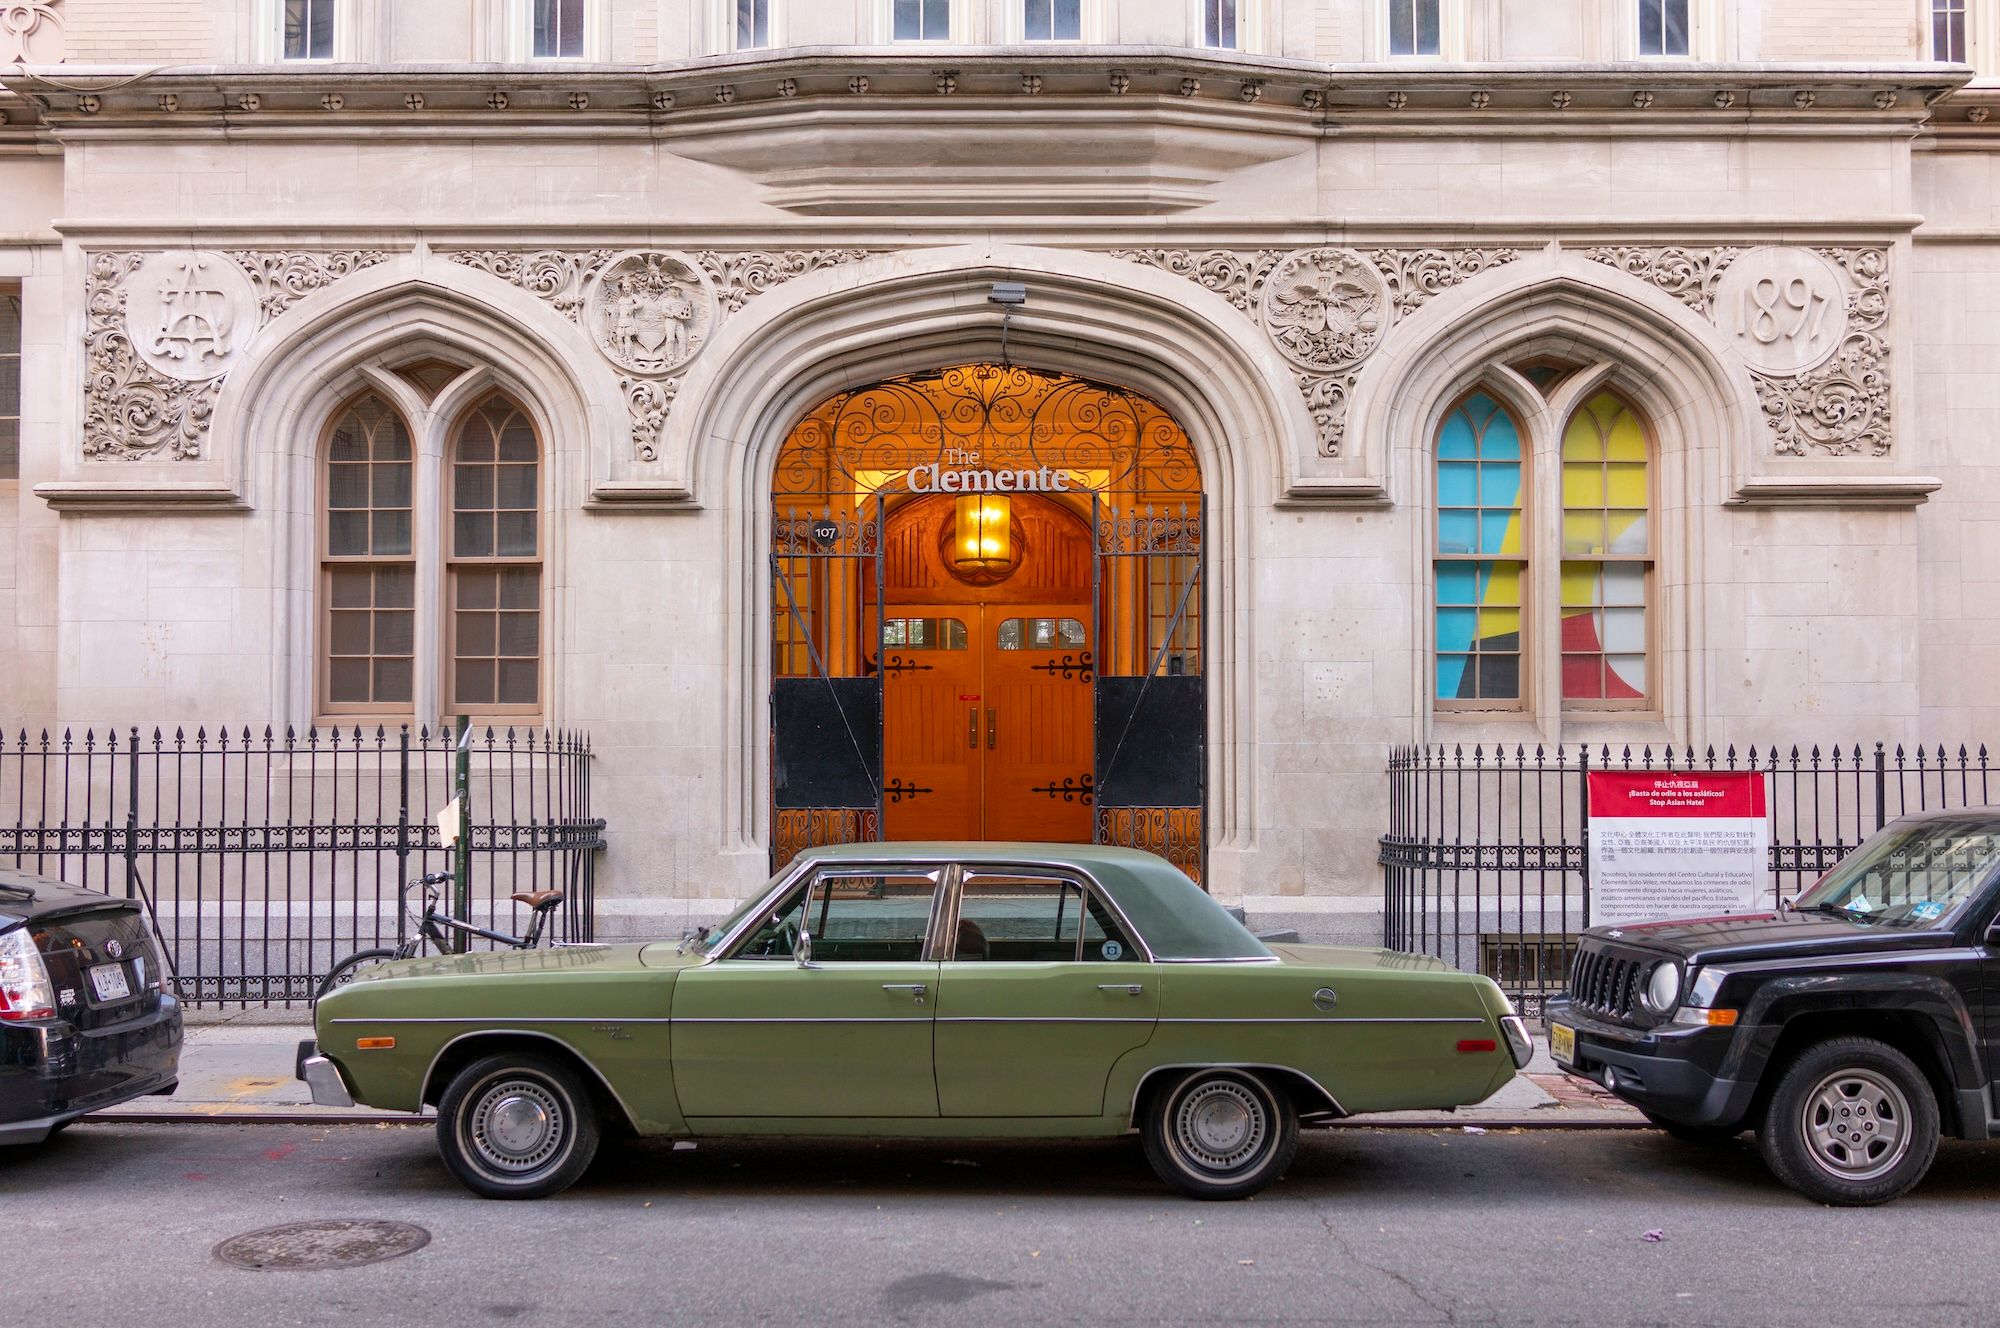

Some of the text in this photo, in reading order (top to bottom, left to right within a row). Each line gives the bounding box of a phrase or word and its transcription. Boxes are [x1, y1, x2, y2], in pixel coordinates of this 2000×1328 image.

[1735, 277, 1831, 343] 1897
[944, 447, 980, 465] The
[906, 462, 1071, 493] Clemente
[815, 527, 836, 540] 107
[1628, 790, 1650, 798] ¡Basta
[1649, 799, 1666, 807] Stop
